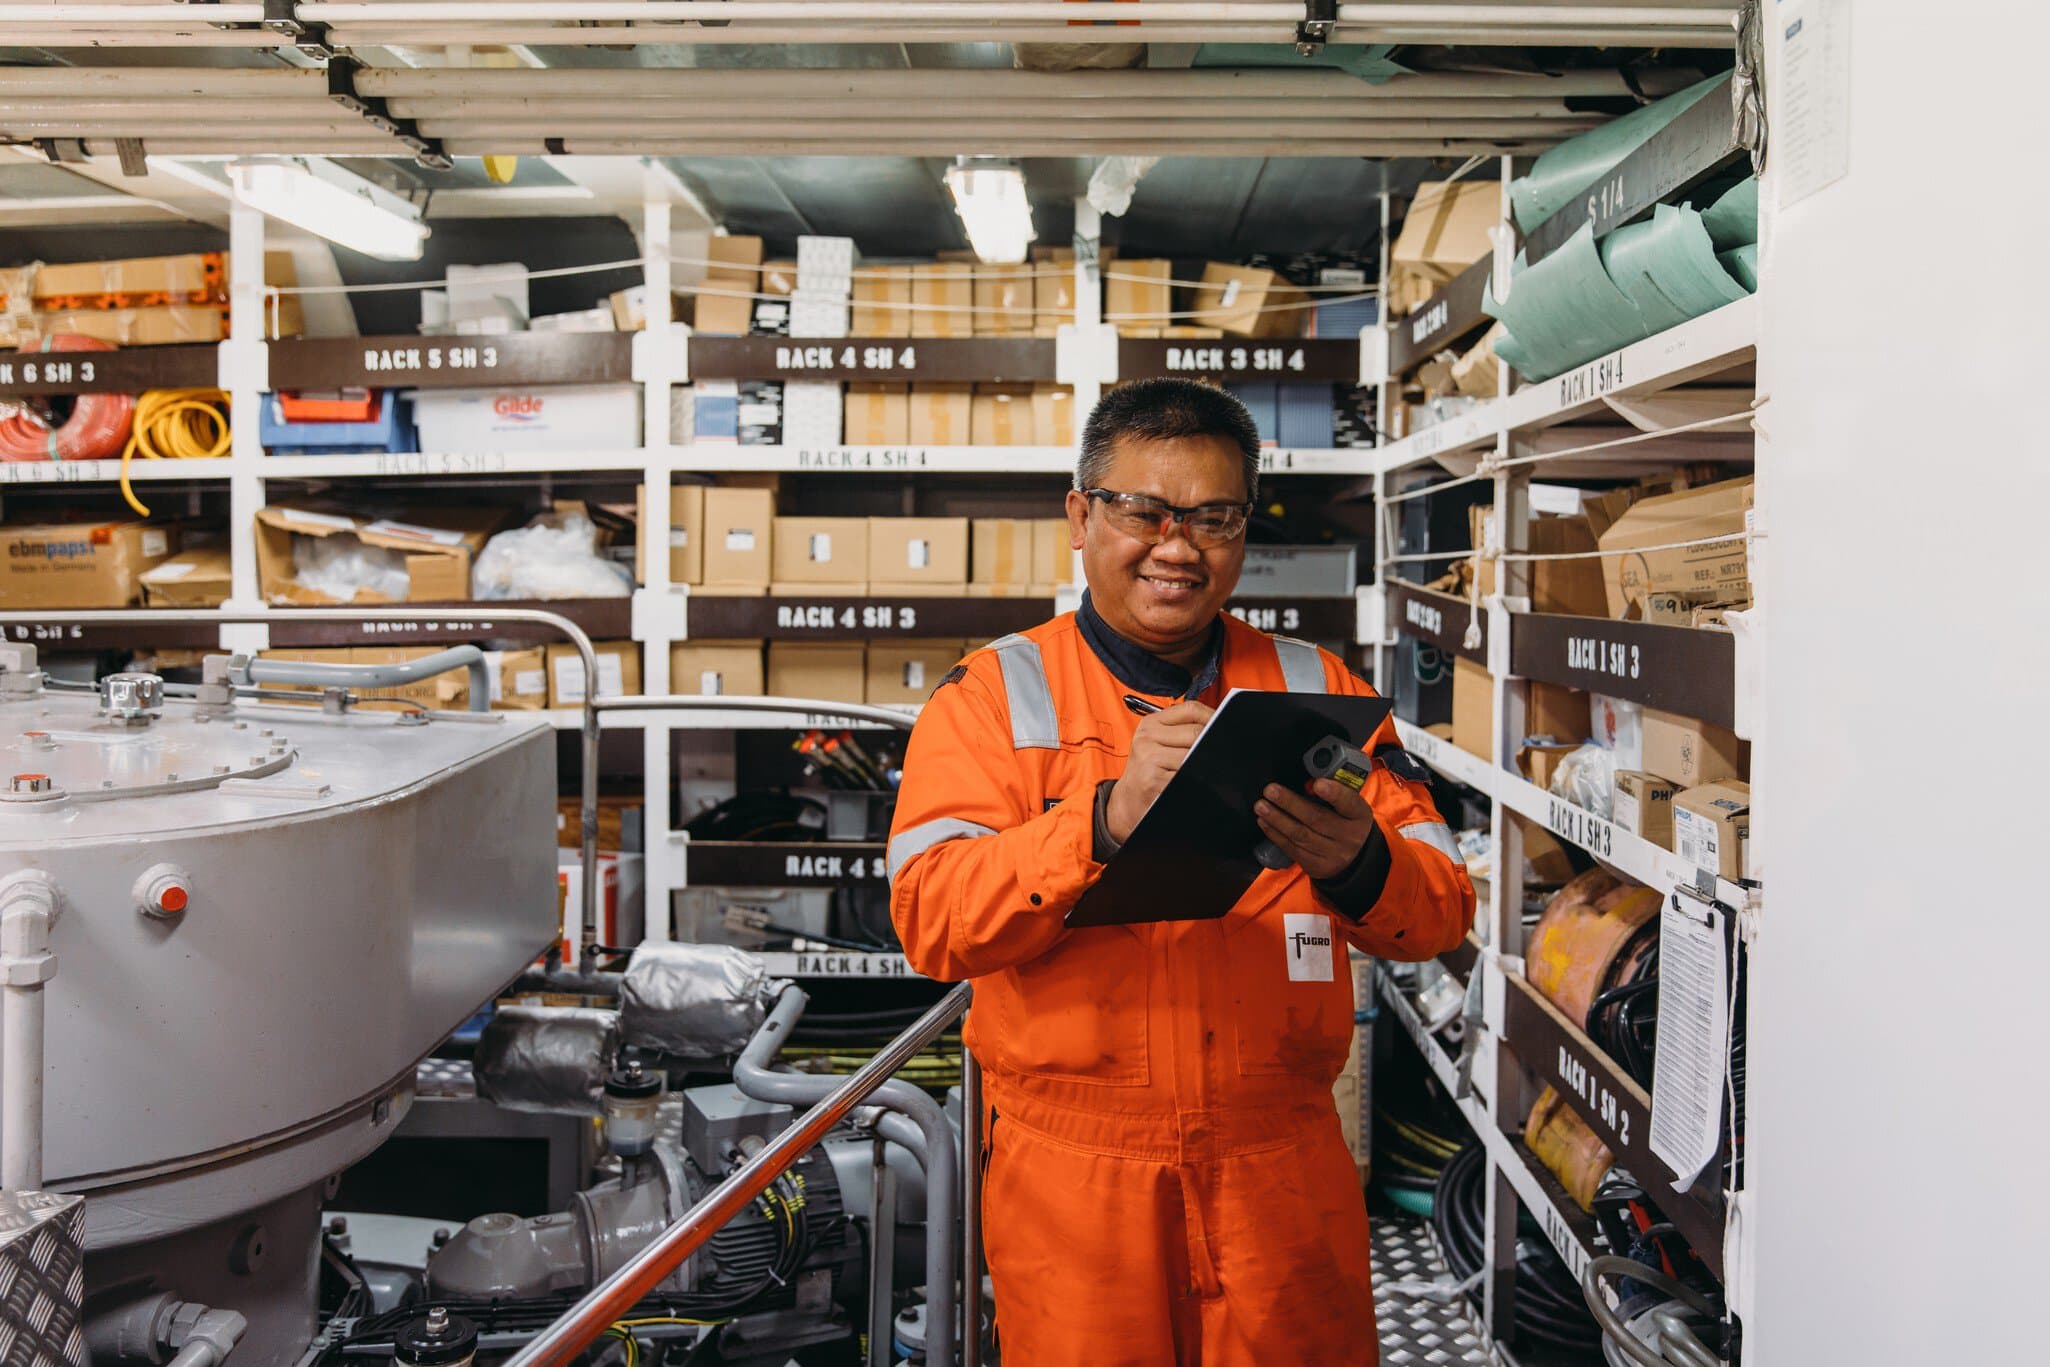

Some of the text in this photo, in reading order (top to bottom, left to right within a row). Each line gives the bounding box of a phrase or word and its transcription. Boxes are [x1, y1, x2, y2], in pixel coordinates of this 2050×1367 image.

[364, 346, 498, 372] RACK 5 SH 3
[776, 345, 916, 370] RACK 4 SH 4
[1166, 347, 1306, 372] RACK 3 SH 4
[23, 363, 38, 384] 6
[44, 362, 73, 384] SH
[80, 361, 96, 382] 3
[1561, 370, 1586, 407] RACK
[1600, 359, 1613, 392] SH
[1616, 351, 1624, 383] 4
[799, 451, 926, 466] RACK 4 SH 4
[777, 606, 916, 629] RACK 4 SH 3
[1247, 608, 1277, 630] SH
[1283, 608, 1299, 630] 3
[1568, 637, 1640, 679] RACK 1 SH 3
[1549, 799, 1575, 842] RACK
[1587, 818, 1602, 853] SH
[1604, 825, 1611, 857] 3
[786, 855, 887, 878] RACK 4 S
[797, 957, 905, 974] RACK 4 SH
[1559, 1045, 1630, 1147] RACK 1 SH 2
[1546, 1206, 1571, 1268] RACK
